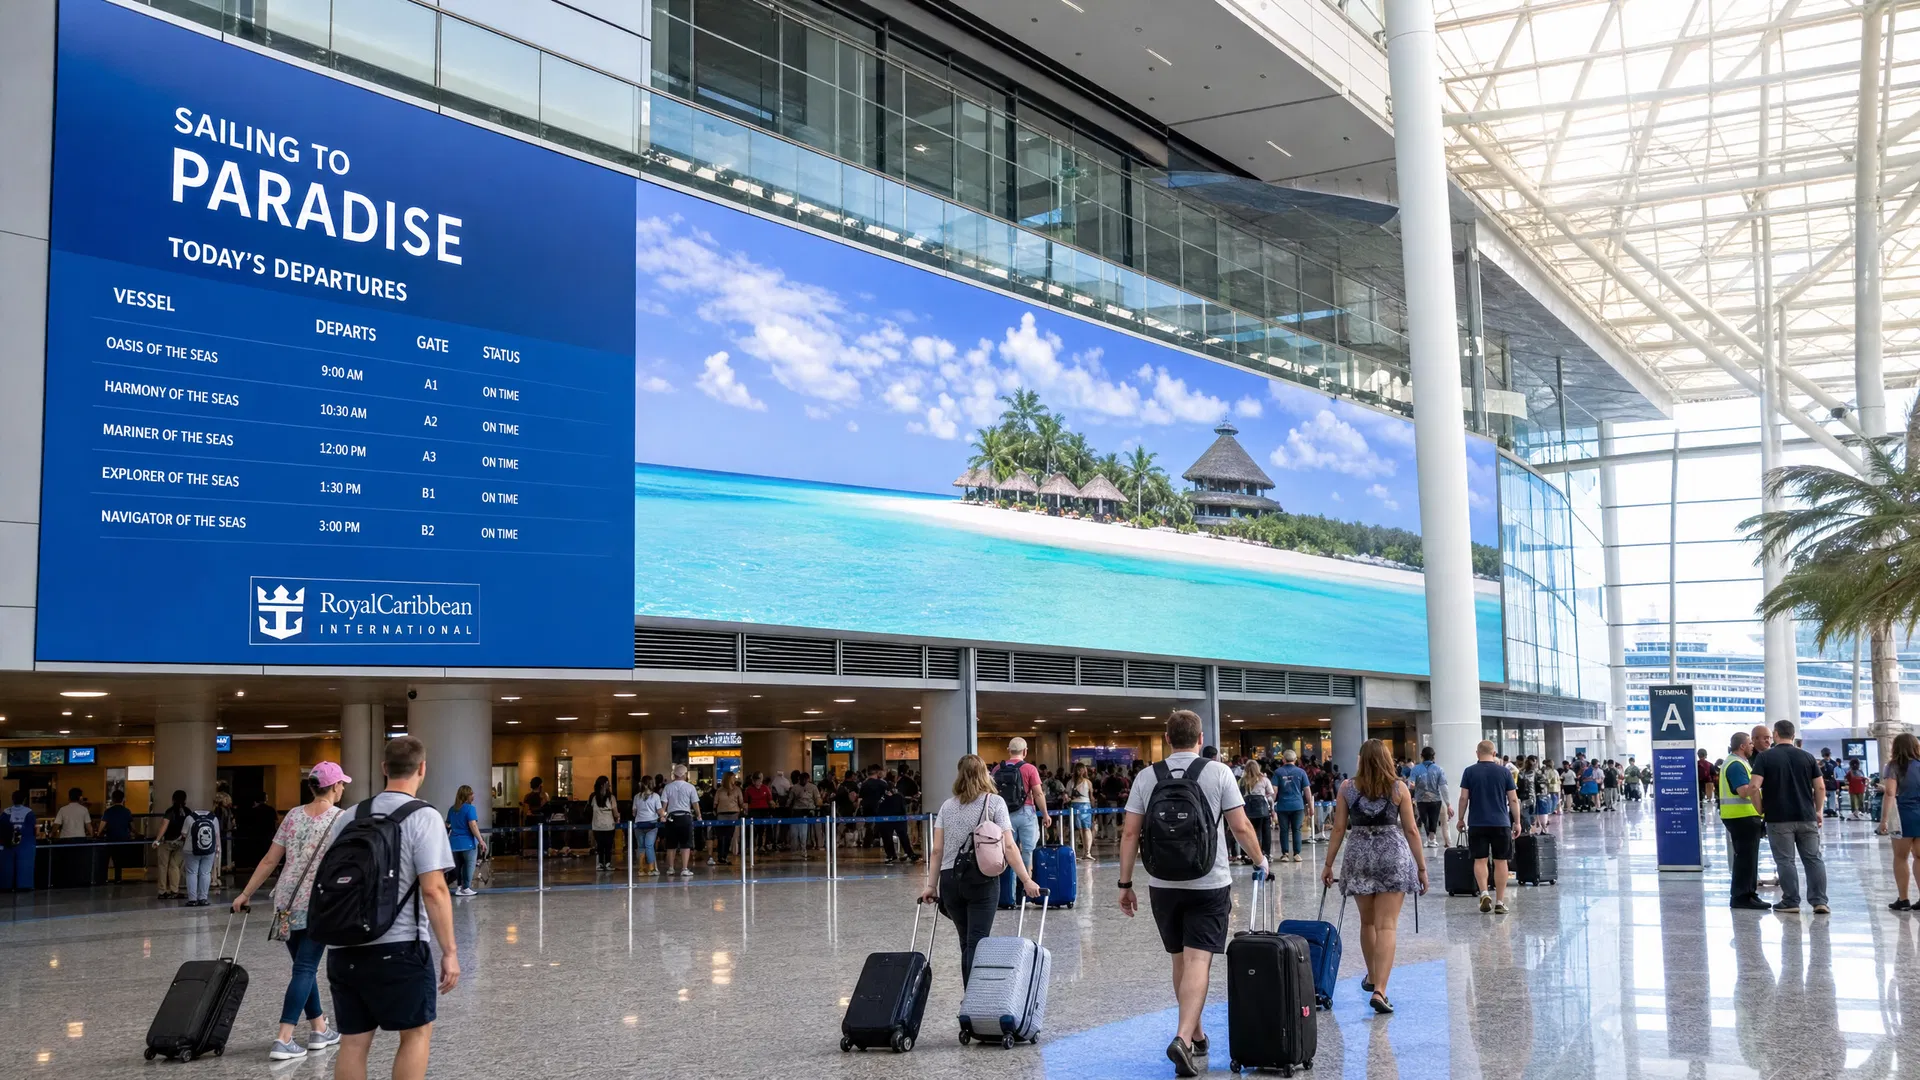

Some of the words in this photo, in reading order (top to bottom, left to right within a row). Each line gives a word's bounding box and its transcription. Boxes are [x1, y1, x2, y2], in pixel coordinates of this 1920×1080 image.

[174, 107, 300, 163] SAILING
[311, 142, 351, 176] TO
[172, 147, 463, 266] PARADISE
[168, 236, 266, 275] TODAY’S
[274, 258, 408, 302] DEPARTURES
[113, 287, 176, 312] VESSEL
[315, 319, 377, 342] DEPARTS
[106, 336, 144, 353] OASIS
[146, 342, 163, 356] OF
[164, 345, 188, 359] THE
[190, 348, 219, 364] SEAS
[416, 335, 449, 353] GATE
[483, 345, 521, 364] STATUS
[321, 364, 345, 379] 9:00
[346, 368, 363, 381] AM
[424, 378, 438, 391] A1
[104, 379, 167, 398] HARMONY
[168, 387, 185, 400] OF
[186, 389, 209, 403] THE
[211, 392, 240, 407] SEAS
[482, 386, 497, 398] ON
[498, 388, 520, 401] TIME
[320, 403, 349, 417] 10:30
[350, 407, 367, 419] AM
[423, 415, 438, 427] A2
[482, 421, 497, 433] ON
[498, 422, 519, 436] TIME
[103, 423, 159, 440] MARINER
[162, 428, 179, 441] OF
[180, 430, 203, 444] THE
[205, 432, 234, 446] SEAS
[320, 442, 349, 456] 12:00
[350, 445, 366, 457] PM
[422, 450, 437, 463] A3
[482, 456, 496, 468] ON
[497, 457, 519, 470] TIME
[102, 466, 165, 483] EXPLORER
[168, 471, 184, 484] OF
[186, 472, 209, 486] THE
[211, 474, 240, 488] SEAS
[320, 481, 343, 494] 1:30
[345, 482, 361, 495] PM
[422, 487, 436, 499] B1
[481, 491, 496, 503] ON
[497, 493, 519, 505] TIME
[101, 509, 173, 526] NAVIGATOR
[175, 513, 192, 526] OF
[193, 514, 216, 527] THE
[218, 515, 247, 529] SEAS
[319, 519, 343, 533] 3:00
[344, 521, 360, 533] PM
[421, 524, 435, 536] B2
[481, 527, 495, 539] ON
[497, 528, 518, 540] TIME
[320, 624, 472, 635] INTERNATIONAL
[1661, 703, 1686, 731] A
